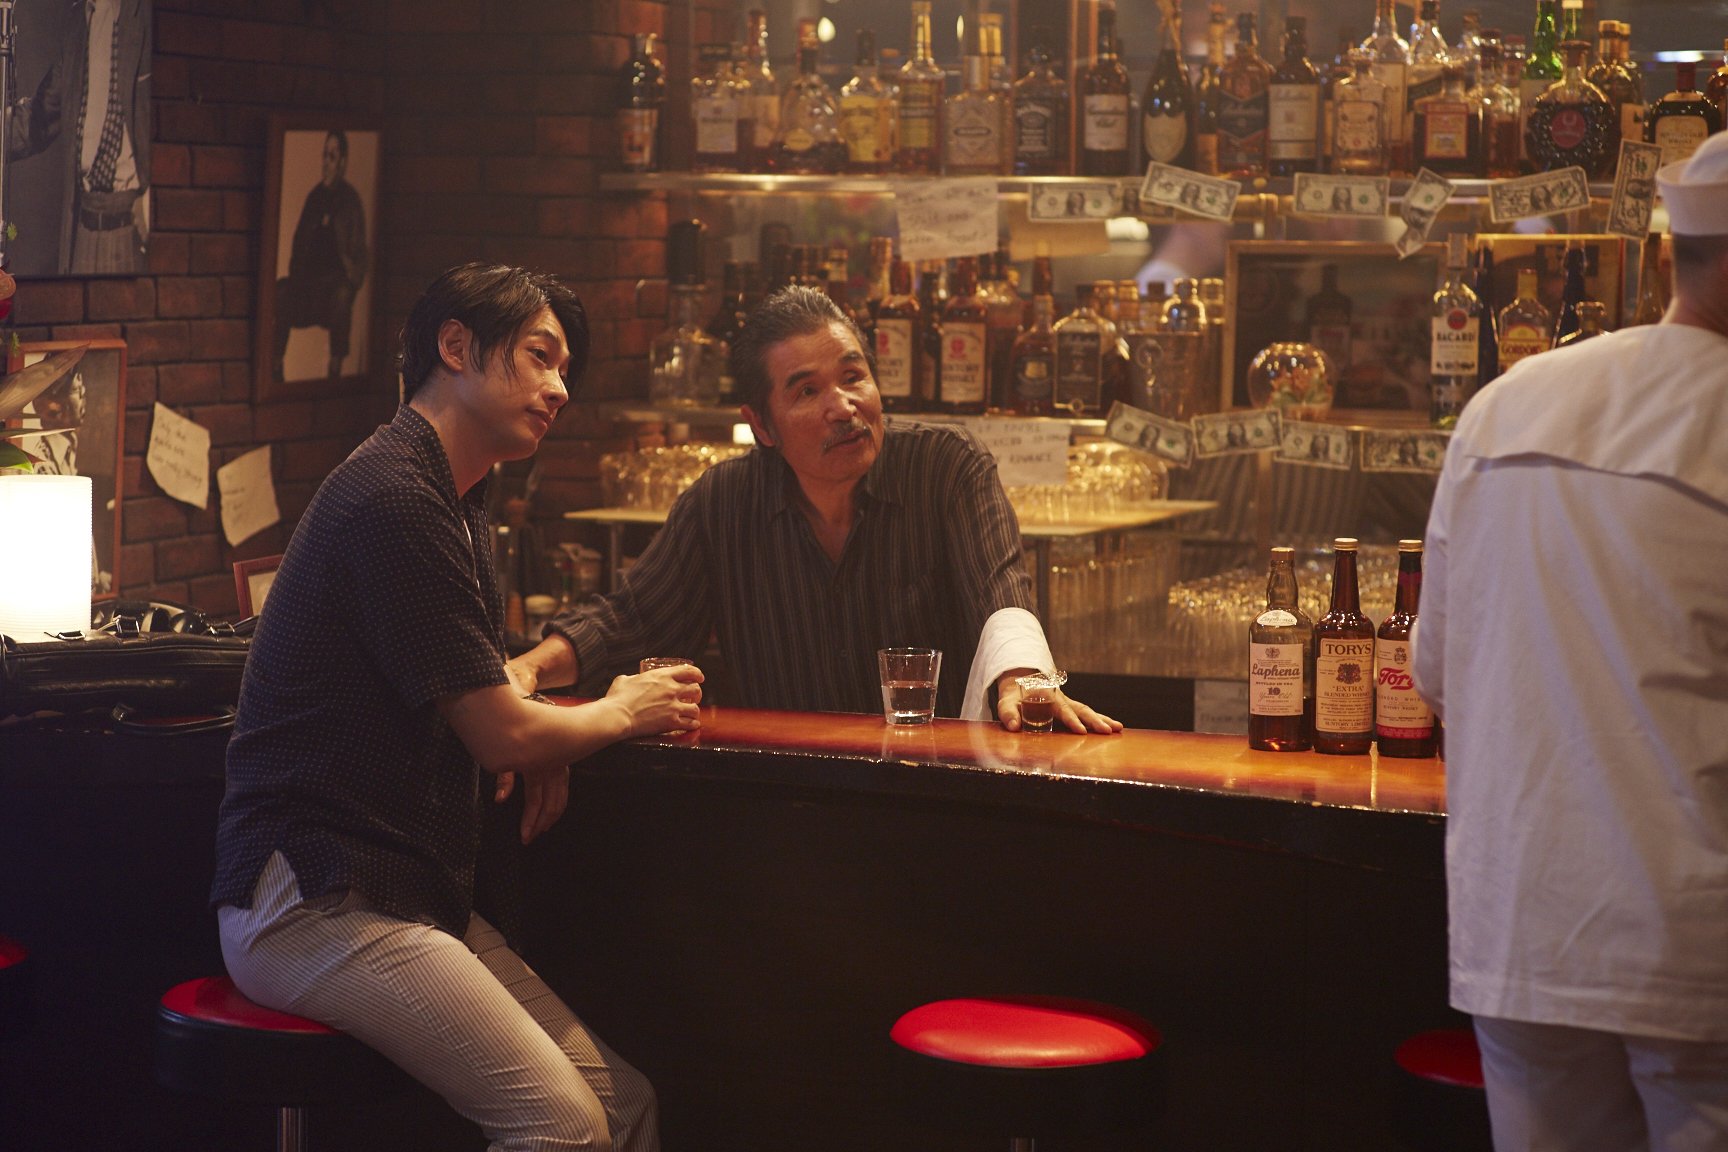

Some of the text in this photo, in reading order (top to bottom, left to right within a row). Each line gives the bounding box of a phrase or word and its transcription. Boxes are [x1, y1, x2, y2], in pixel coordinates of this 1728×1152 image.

[1325, 643, 1372, 656] TORYS
[1251, 662, 1301, 680] Laphena
[1267, 686, 1281, 696] 10
